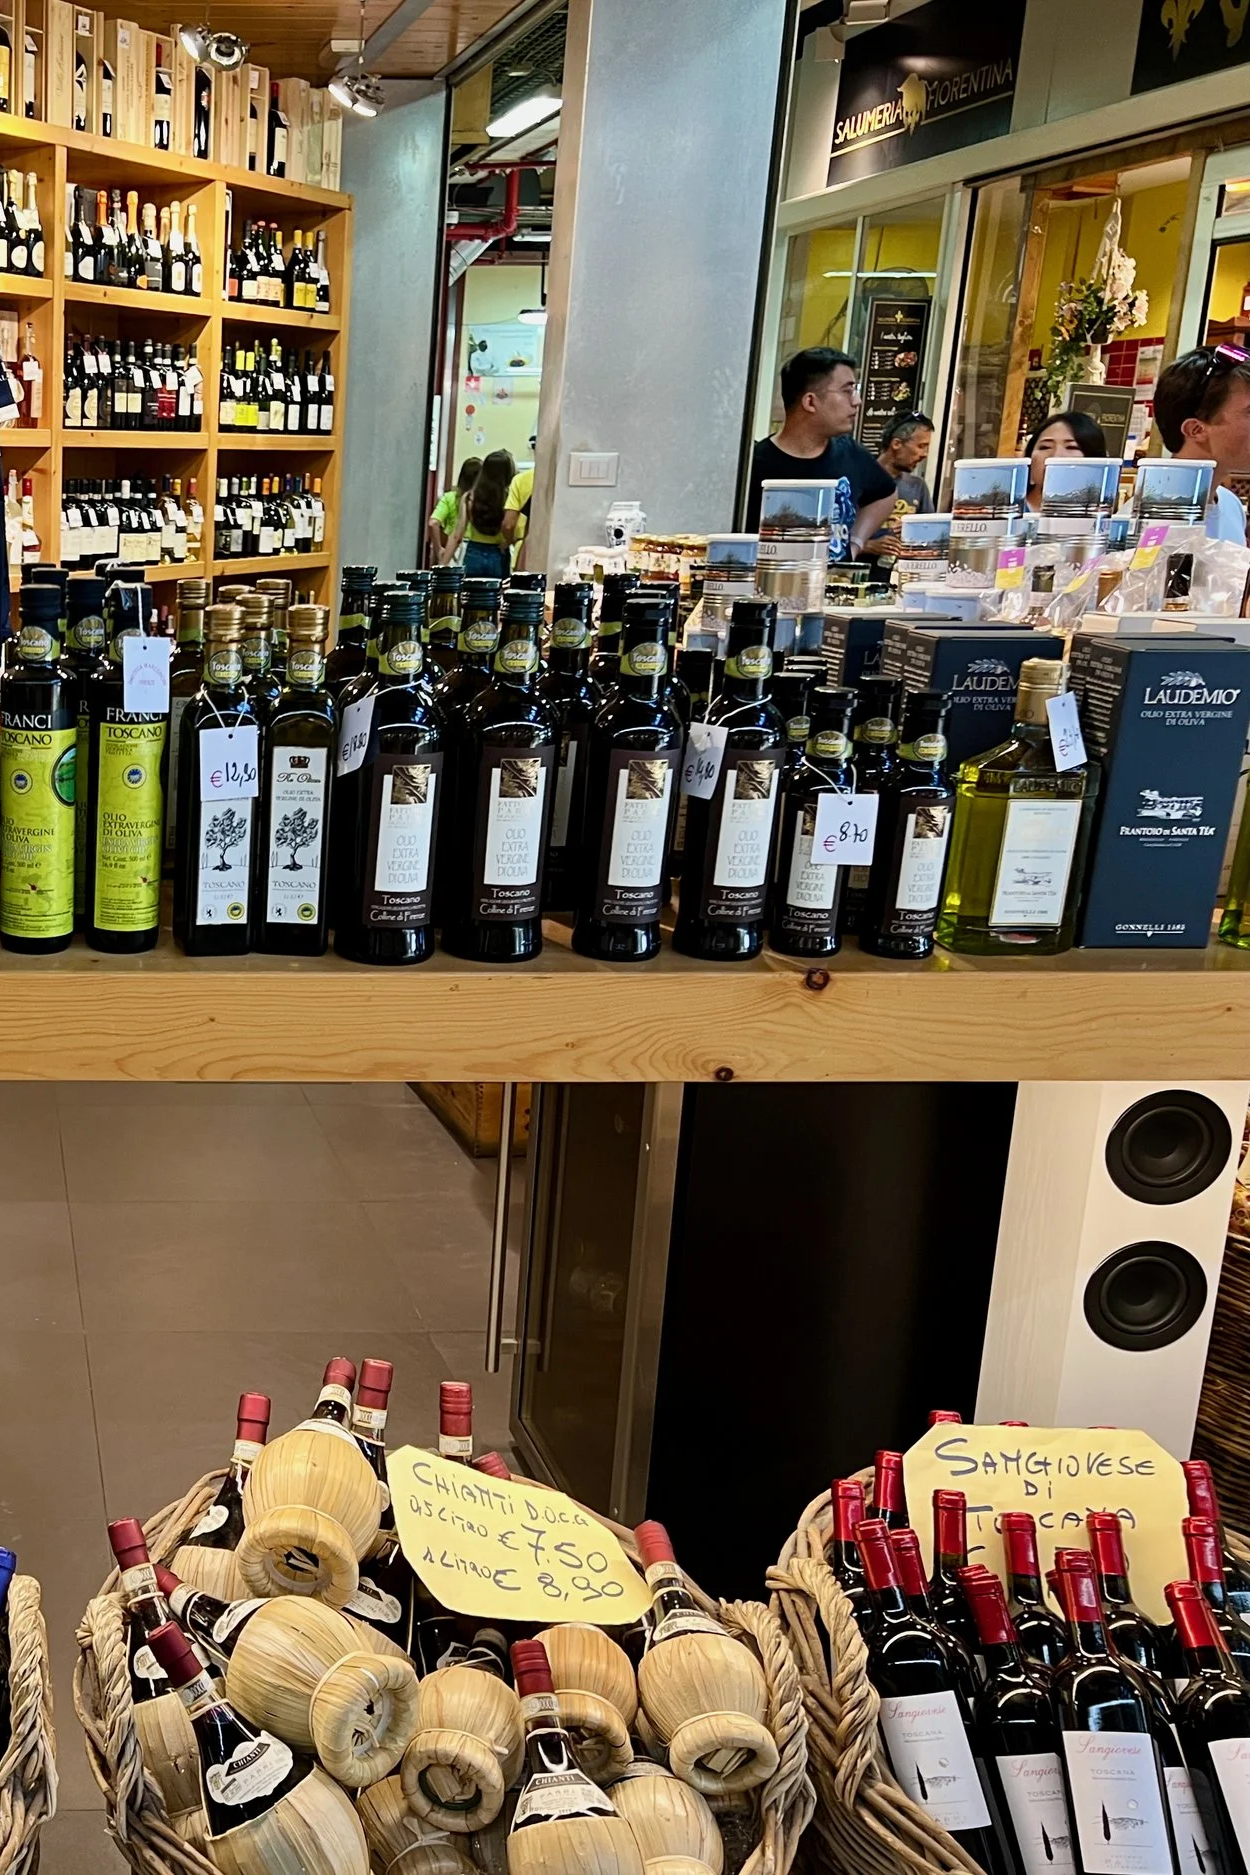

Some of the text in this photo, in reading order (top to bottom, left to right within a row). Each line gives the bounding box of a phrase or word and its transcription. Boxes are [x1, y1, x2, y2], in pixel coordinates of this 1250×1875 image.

[834, 57, 1013, 145] SALUMERIA FIORENTINA
[1143, 688, 1241, 705] LAUDEMIO
[1195, 711, 1233, 719] VERGINE
[107, 726, 162, 738] TOSCANO
[103, 813, 127, 822] OLIO
[116, 829, 143, 837] OLIVA
[505, 828, 526, 839] OLIO
[1120, 826, 1161, 835] FRANTOIO
[1171, 826, 1197, 835] SANTA
[501, 842, 529, 853] EXTRA
[496, 853, 530, 864] VERGINE
[272, 880, 316, 888] TOSCANO
[491, 888, 531, 898] Toscano
[614, 890, 654, 899] Toscano
[720, 889, 759, 899] Toscano
[381, 895, 420, 904] Toscano
[479, 903, 505, 915] Colline
[788, 907, 829, 920] Toscano
[370, 910, 396, 922] Colline
[898, 910, 935, 920] Toscano
[934, 1438, 1156, 1477] SANGIOVESE
[888, 1702, 947, 1725] Sangiovese
[901, 1730, 943, 1738] TOSCANA
[1076, 1736, 1142, 1760] Sangiovese
[232, 1746, 262, 1770] CHIANTI
[535, 1775, 575, 1786] CHIANTI
